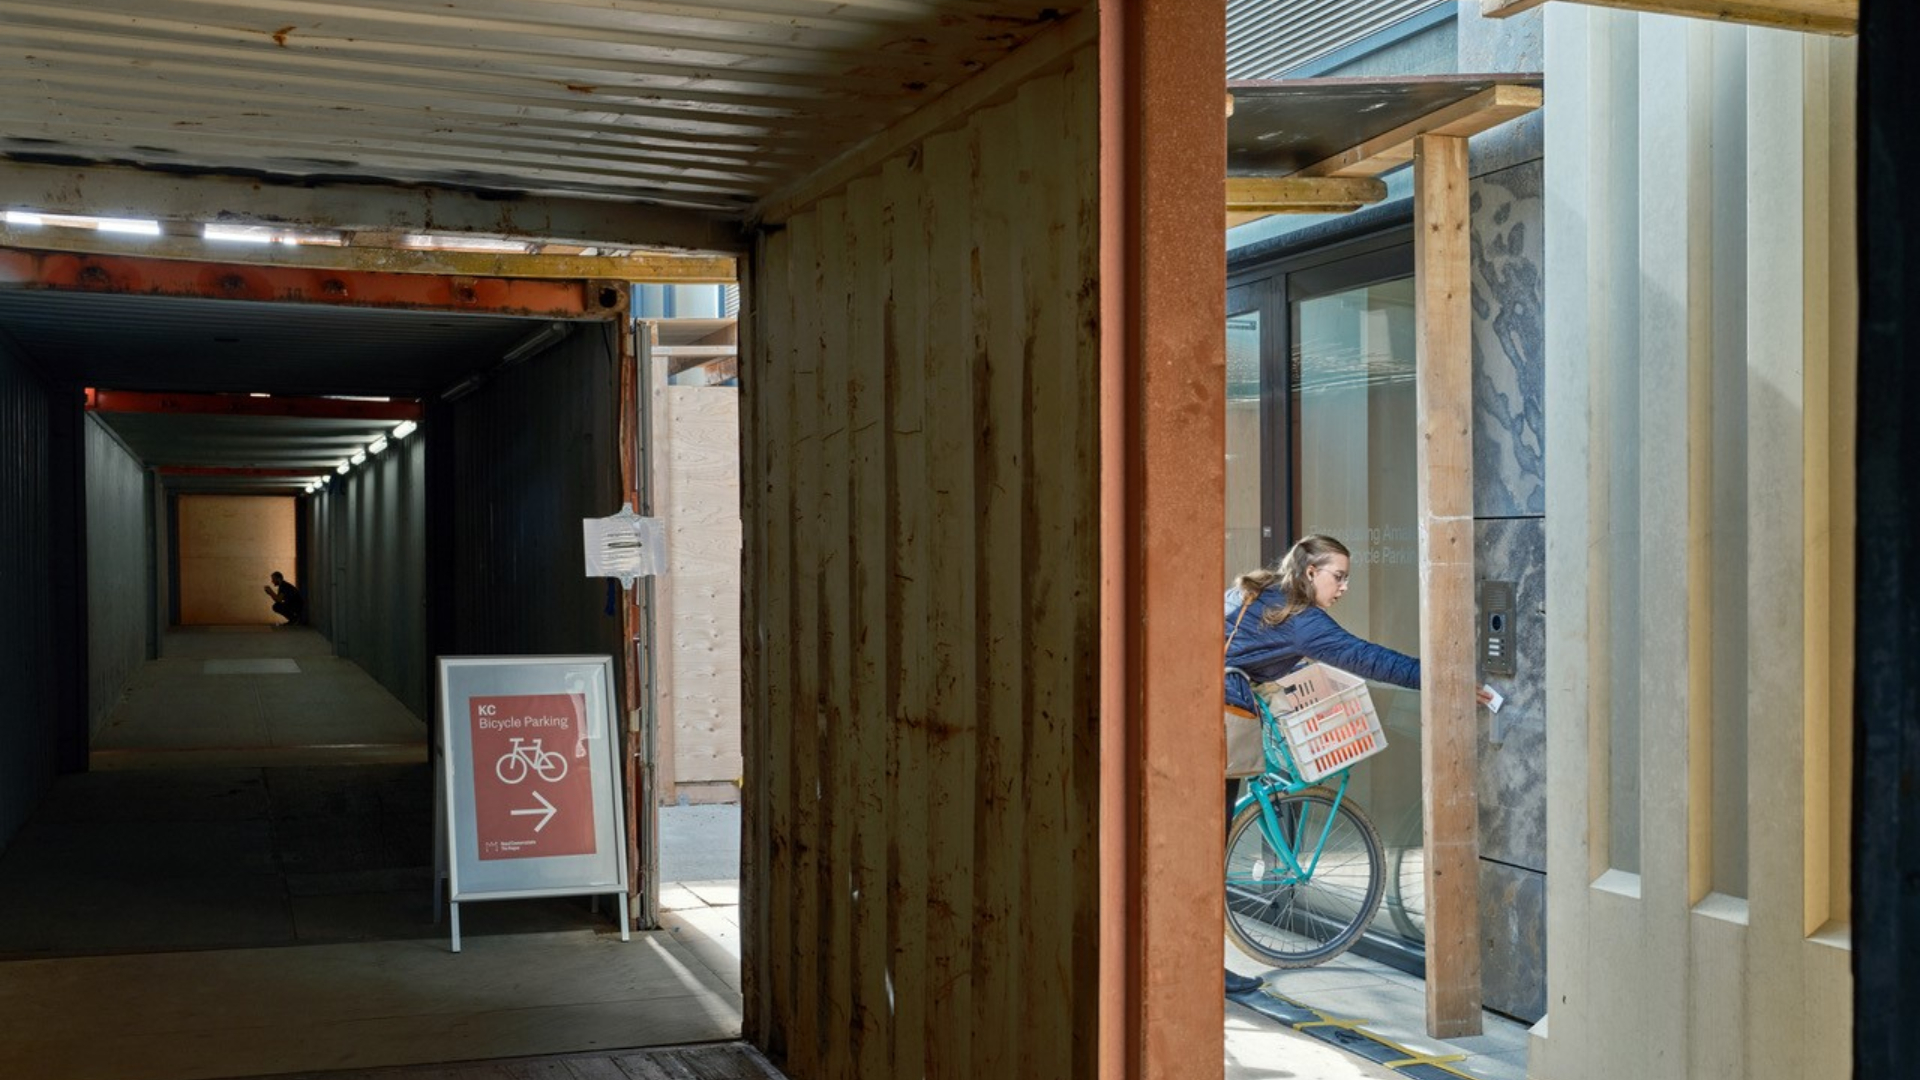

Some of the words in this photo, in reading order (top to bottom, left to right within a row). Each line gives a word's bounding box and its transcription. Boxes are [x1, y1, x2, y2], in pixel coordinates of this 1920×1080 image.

[1383, 547, 1416, 564] Parkin
[478, 704, 496, 716] KC
[479, 716, 521, 731] Bicycle
[524, 715, 569, 730] Parking
